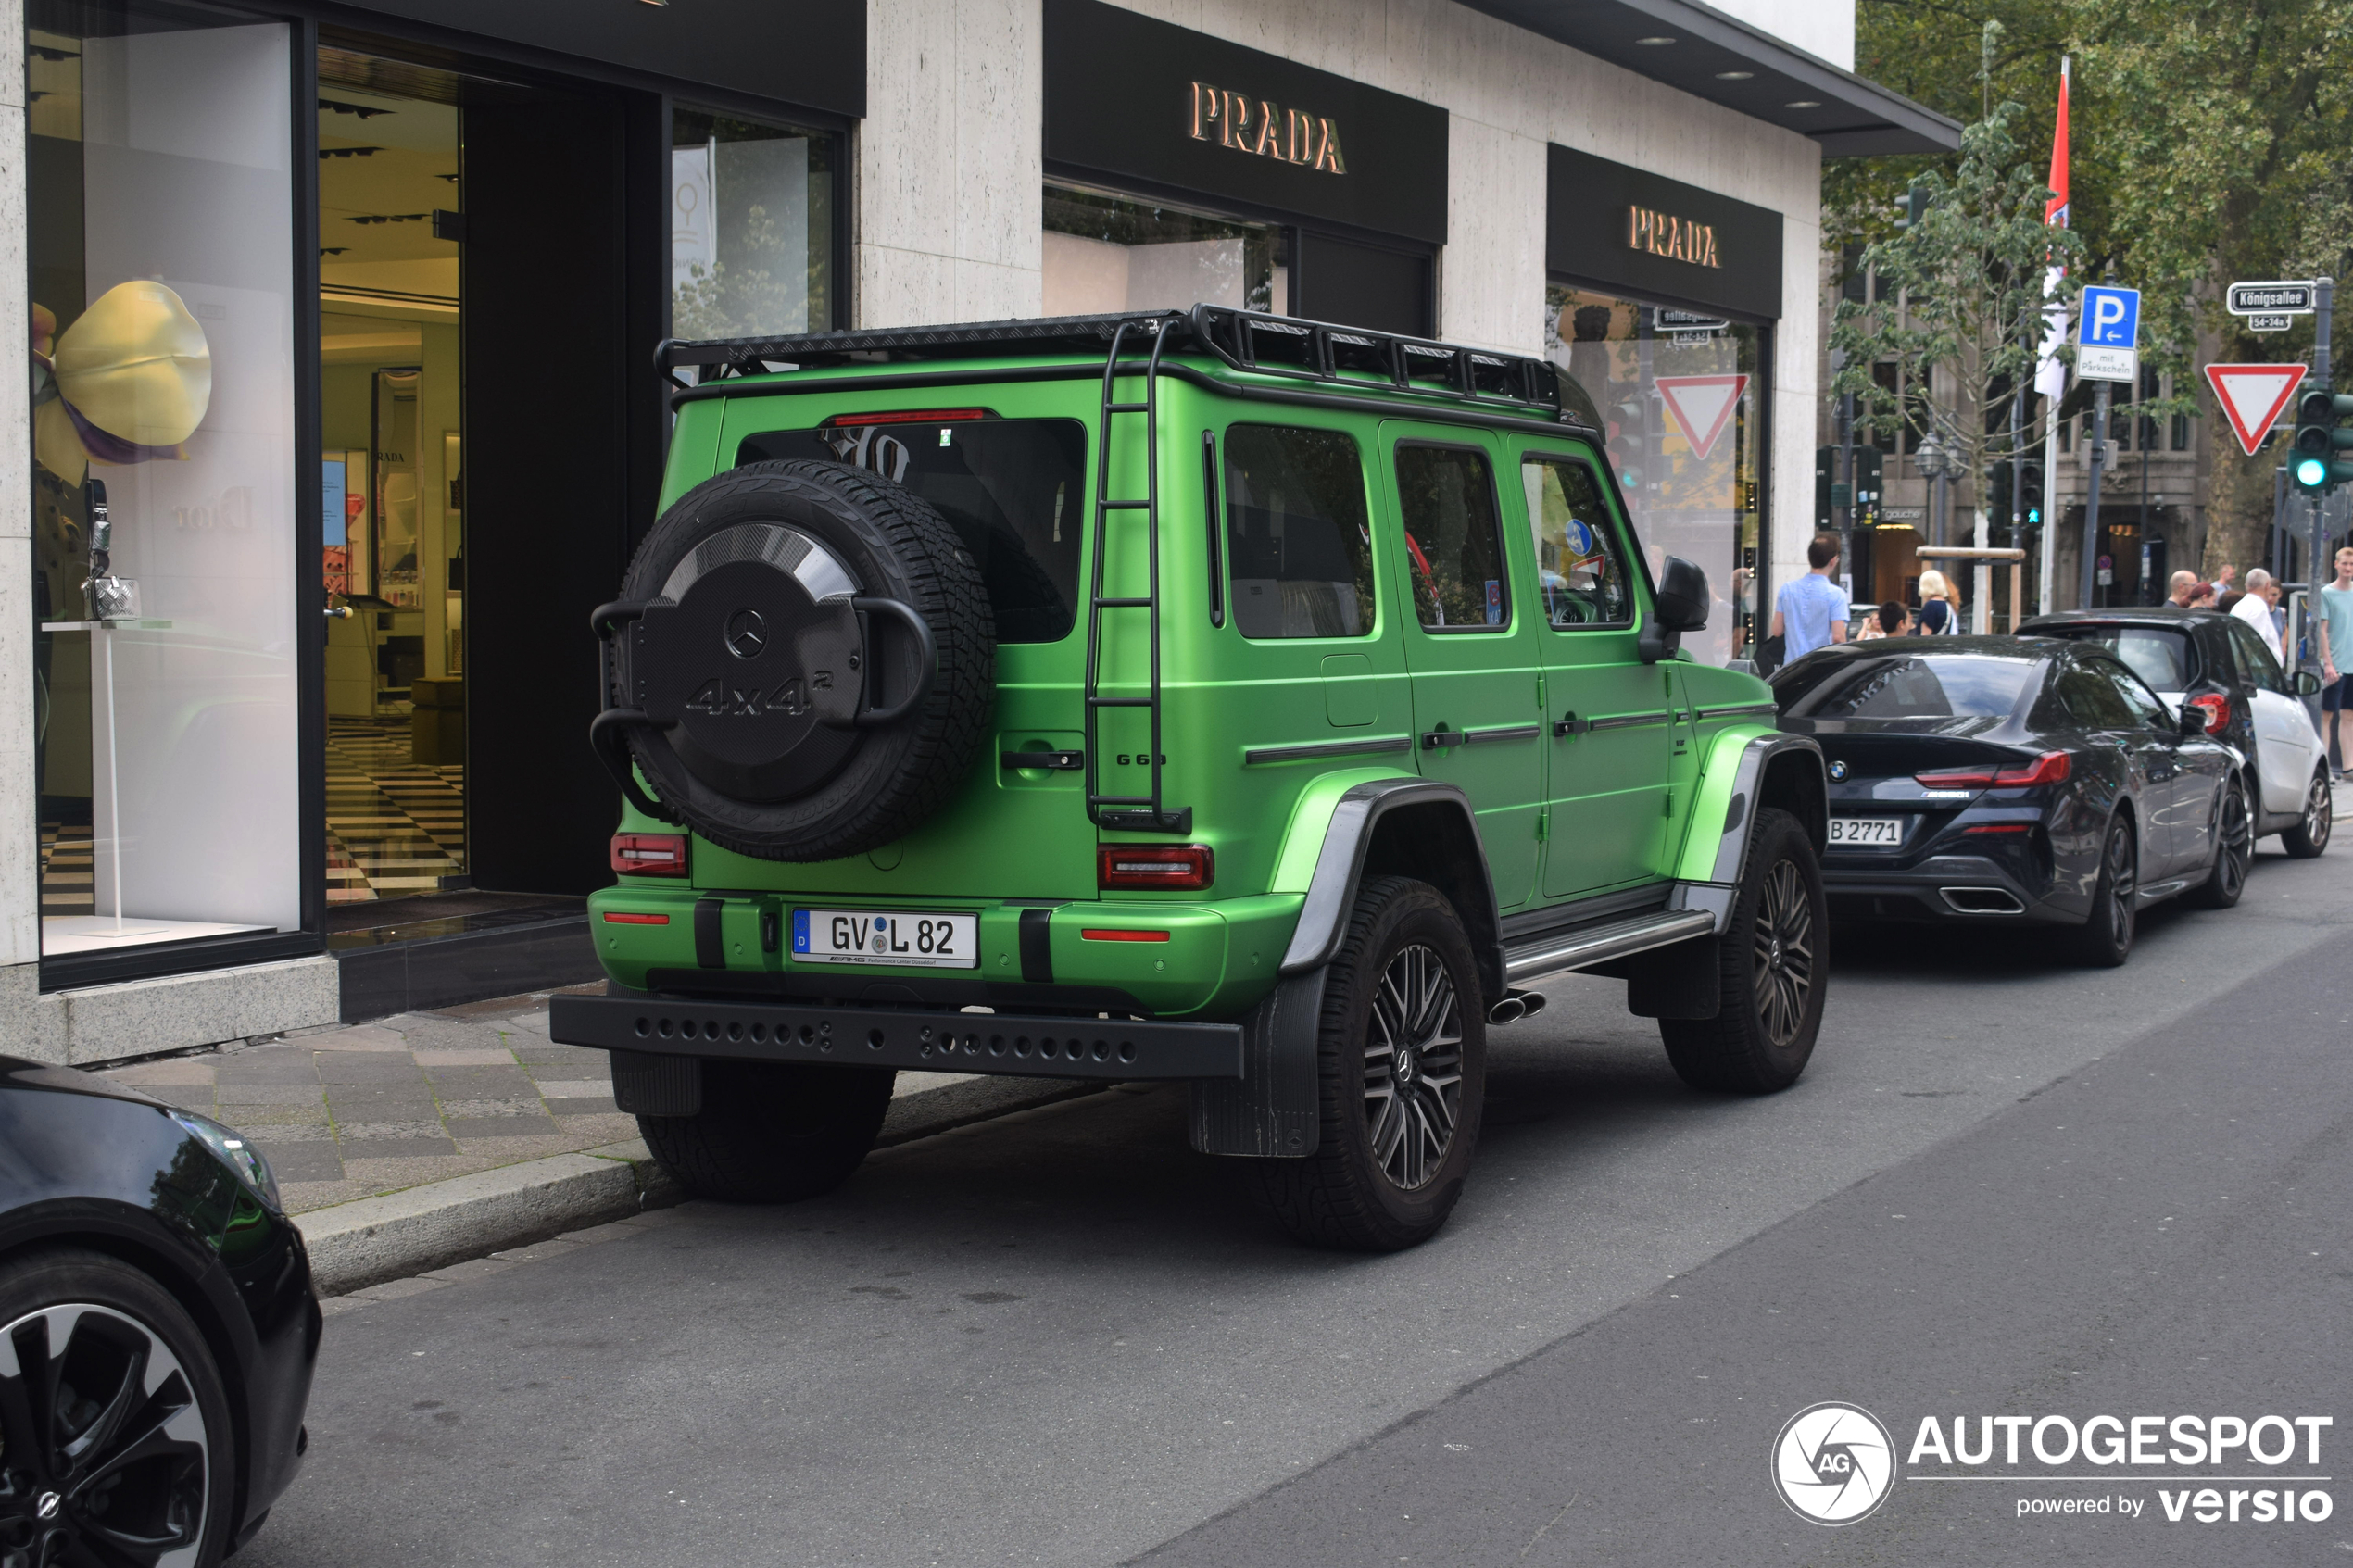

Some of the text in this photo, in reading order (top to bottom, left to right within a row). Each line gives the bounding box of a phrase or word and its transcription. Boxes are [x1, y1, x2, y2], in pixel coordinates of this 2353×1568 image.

[1191, 81, 1347, 175] PRADA
[1630, 205, 1722, 269] PRADA
[2239, 291, 2303, 307] Königsallee
[2092, 295, 2126, 341] P
[2254, 318, 2284, 328] 54-34a
[2100, 355, 2114, 363] mit
[2082, 362, 2131, 374] Parkschein
[370, 451, 405, 463] PRADA
[1884, 509, 1921, 521] gauche
[1831, 822, 1897, 841] B 2771
[798, 936, 806, 947] D
[832, 916, 954, 954] GV L 82
